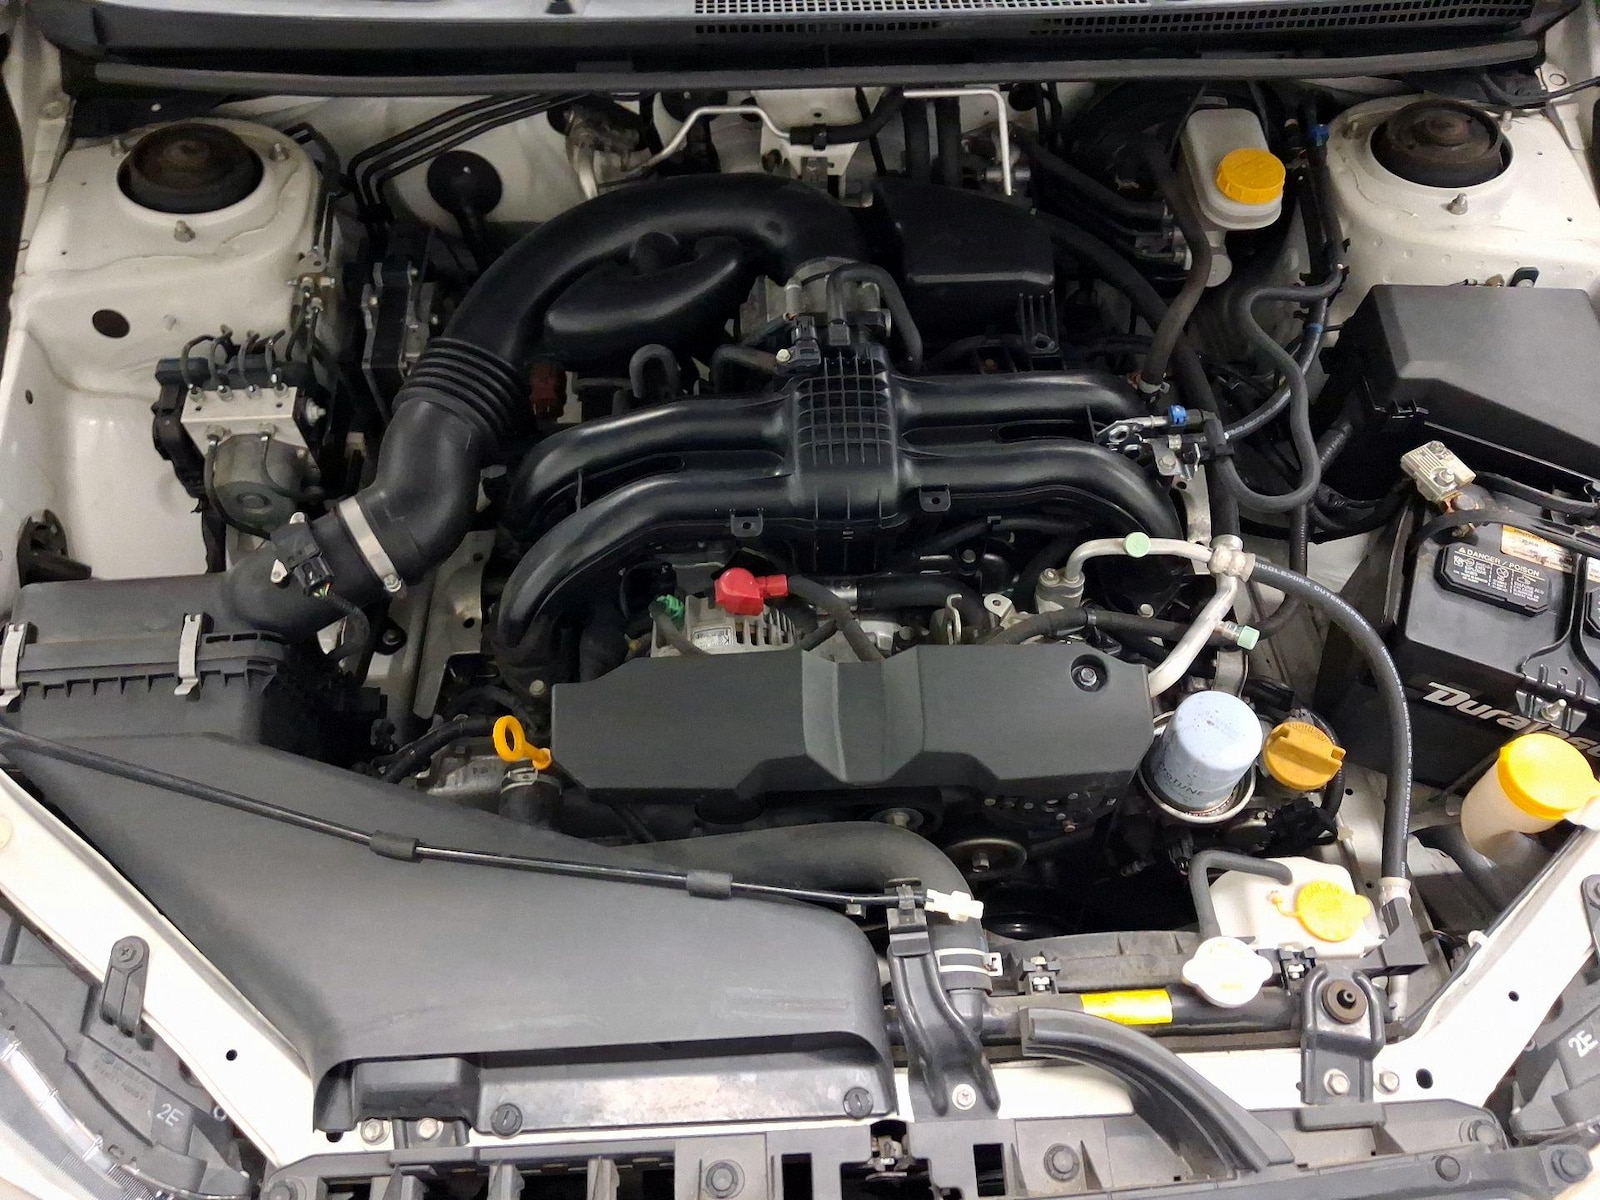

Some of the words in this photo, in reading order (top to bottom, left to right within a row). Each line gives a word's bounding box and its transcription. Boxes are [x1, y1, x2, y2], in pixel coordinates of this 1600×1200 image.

[1467, 549, 1500, 564] DANGER
[1509, 562, 1540, 577] POISON
[1568, 1030, 1599, 1058] 2E
[156, 1103, 184, 1127] 2E
